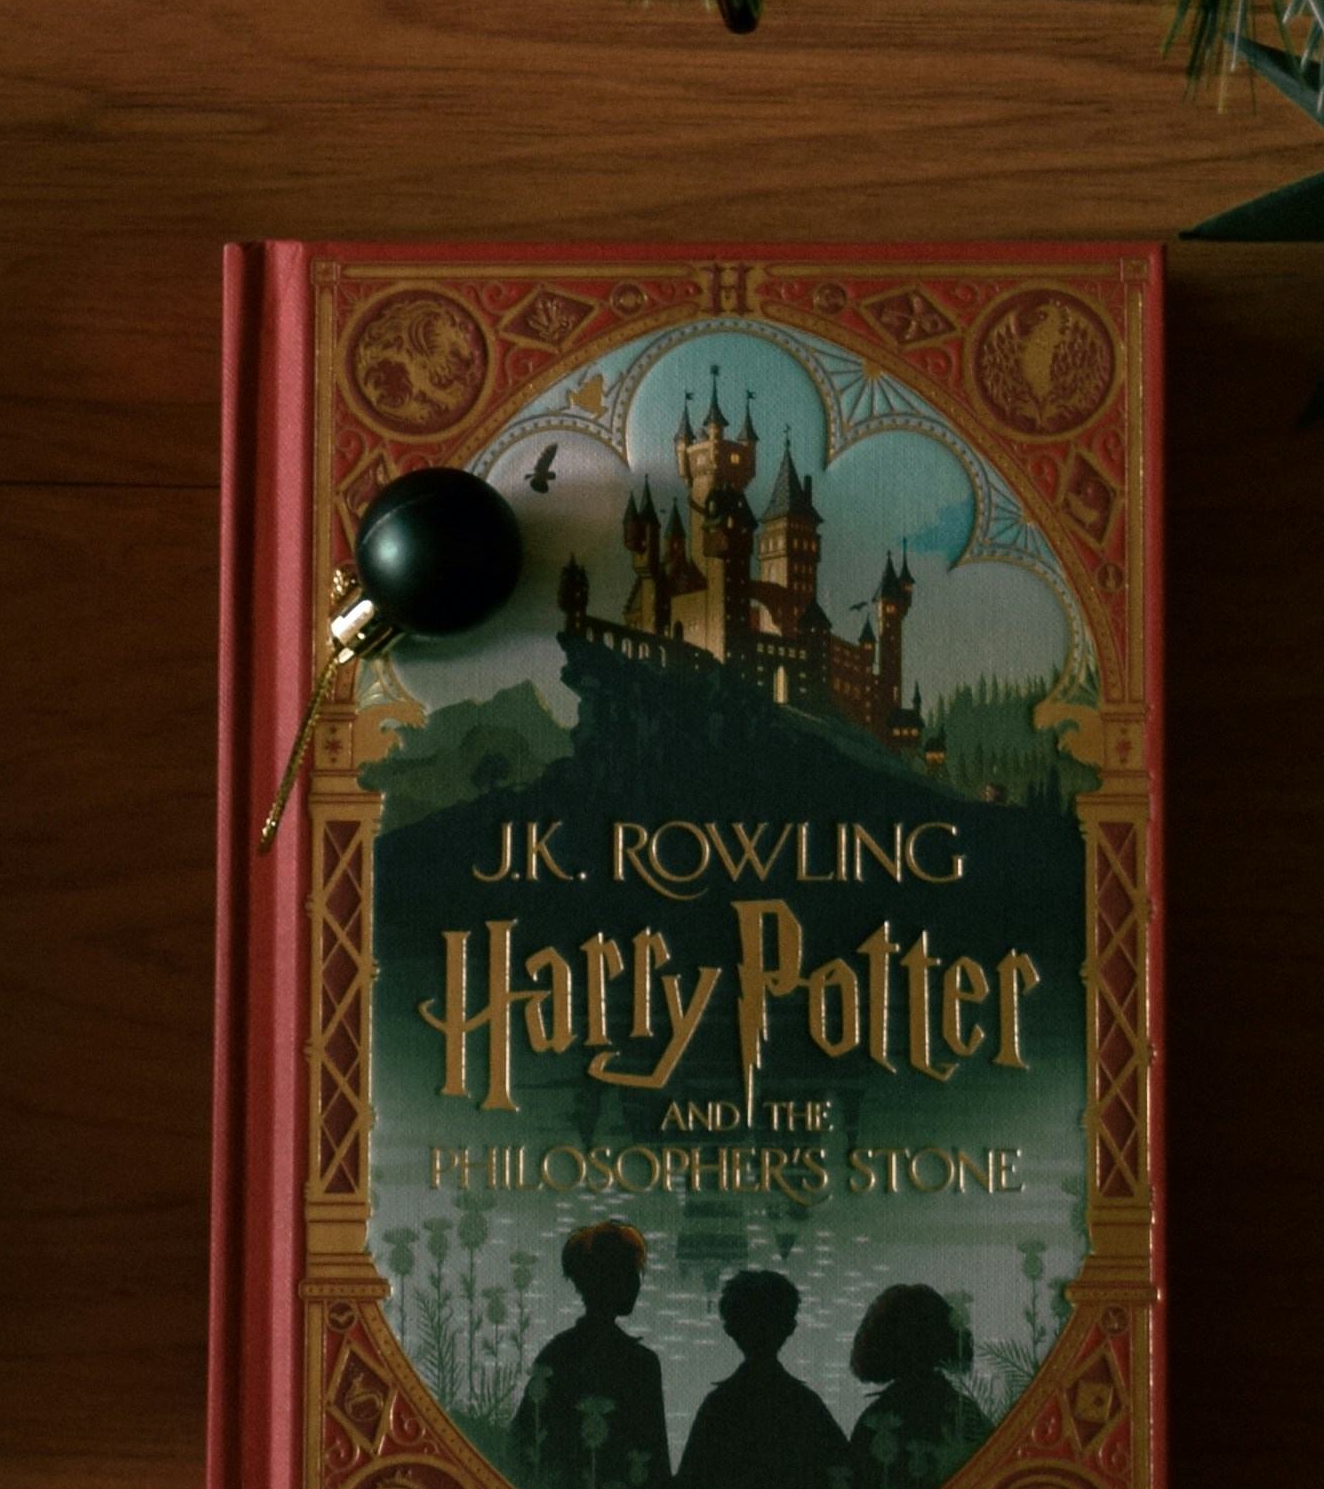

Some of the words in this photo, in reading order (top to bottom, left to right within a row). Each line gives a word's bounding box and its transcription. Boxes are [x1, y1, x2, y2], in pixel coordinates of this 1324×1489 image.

[472, 821, 588, 882] J.K.
[612, 820, 967, 901] ROWLING
[417, 917, 723, 1114] Harry
[729, 897, 1042, 1128] Potter
[661, 1100, 741, 1132] AND
[768, 1099, 836, 1132] THE
[429, 1145, 834, 1207] PHILOSOPHER'S
[850, 1146, 1028, 1195] STONE
